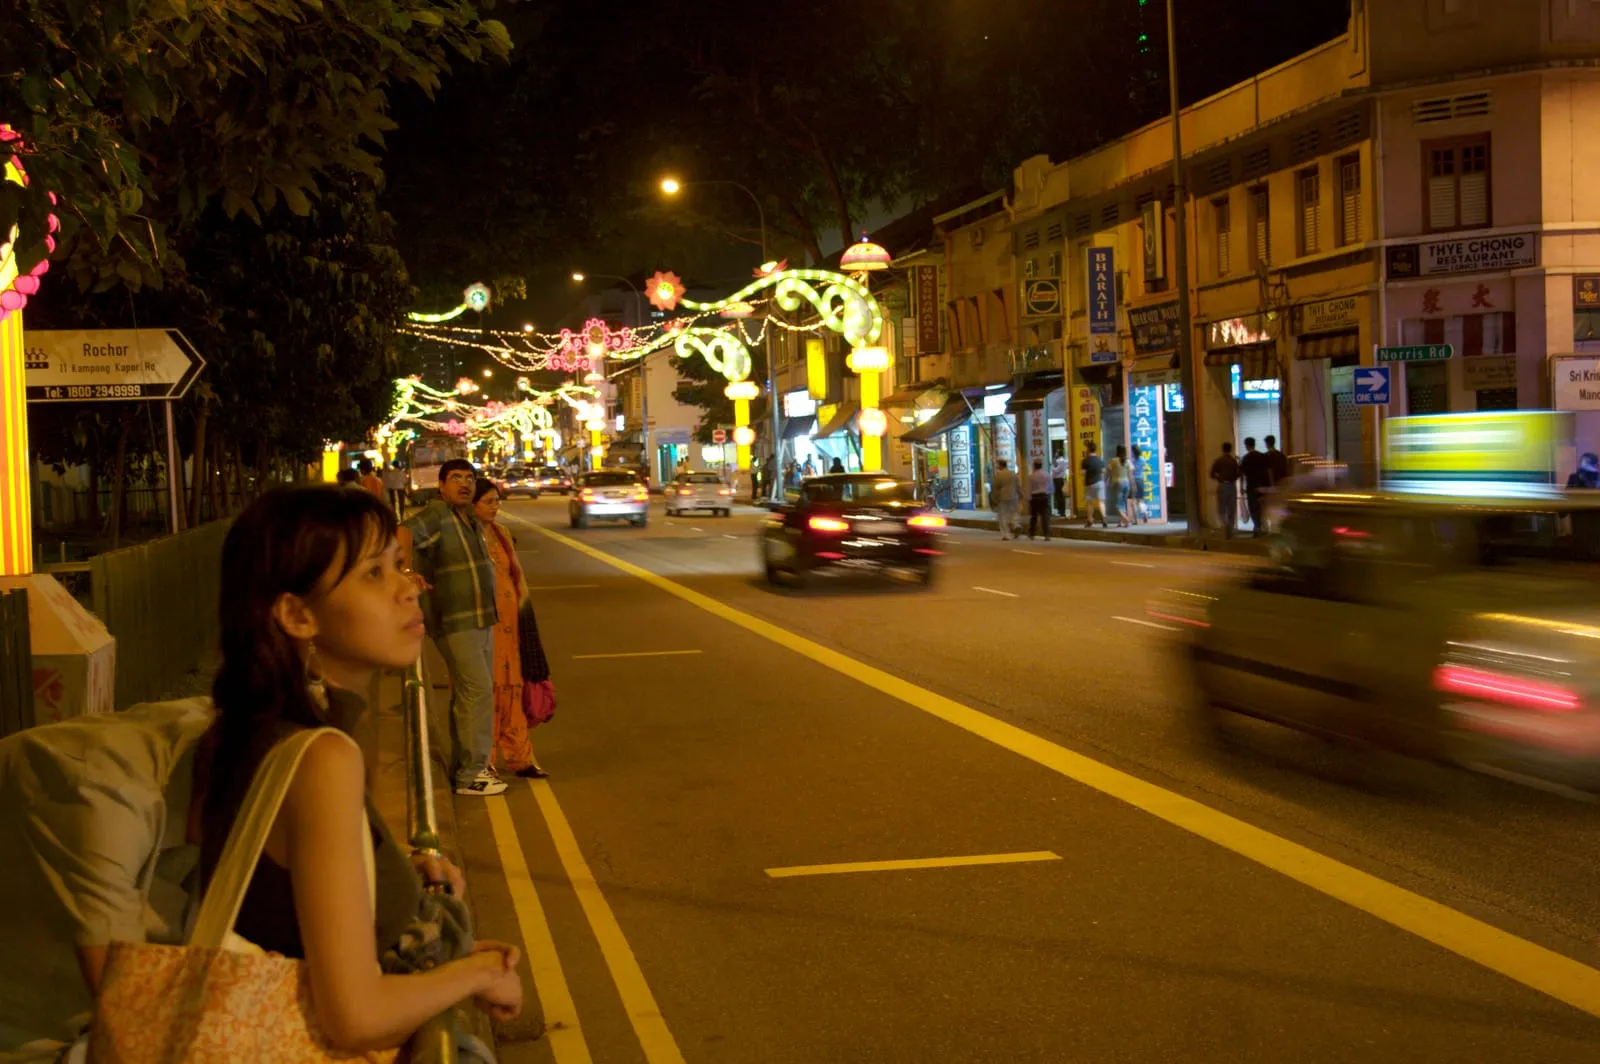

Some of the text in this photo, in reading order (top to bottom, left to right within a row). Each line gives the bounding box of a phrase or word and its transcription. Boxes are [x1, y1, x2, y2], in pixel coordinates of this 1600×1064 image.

[1429, 236, 1525, 257] THYE CHONG
[1436, 250, 1516, 266] RESTAURANT
[1095, 252, 1109, 321] BHARATH
[83, 343, 129, 357] Rochor
[1379, 347, 1447, 361] Norris Rd
[72, 363, 110, 376] Kampong
[144, 361, 156, 372] Rd
[1569, 369, 1581, 382] Sri
[44, 384, 142, 399] Tel: 1800-2949999
[1356, 393, 1370, 403] ONE
